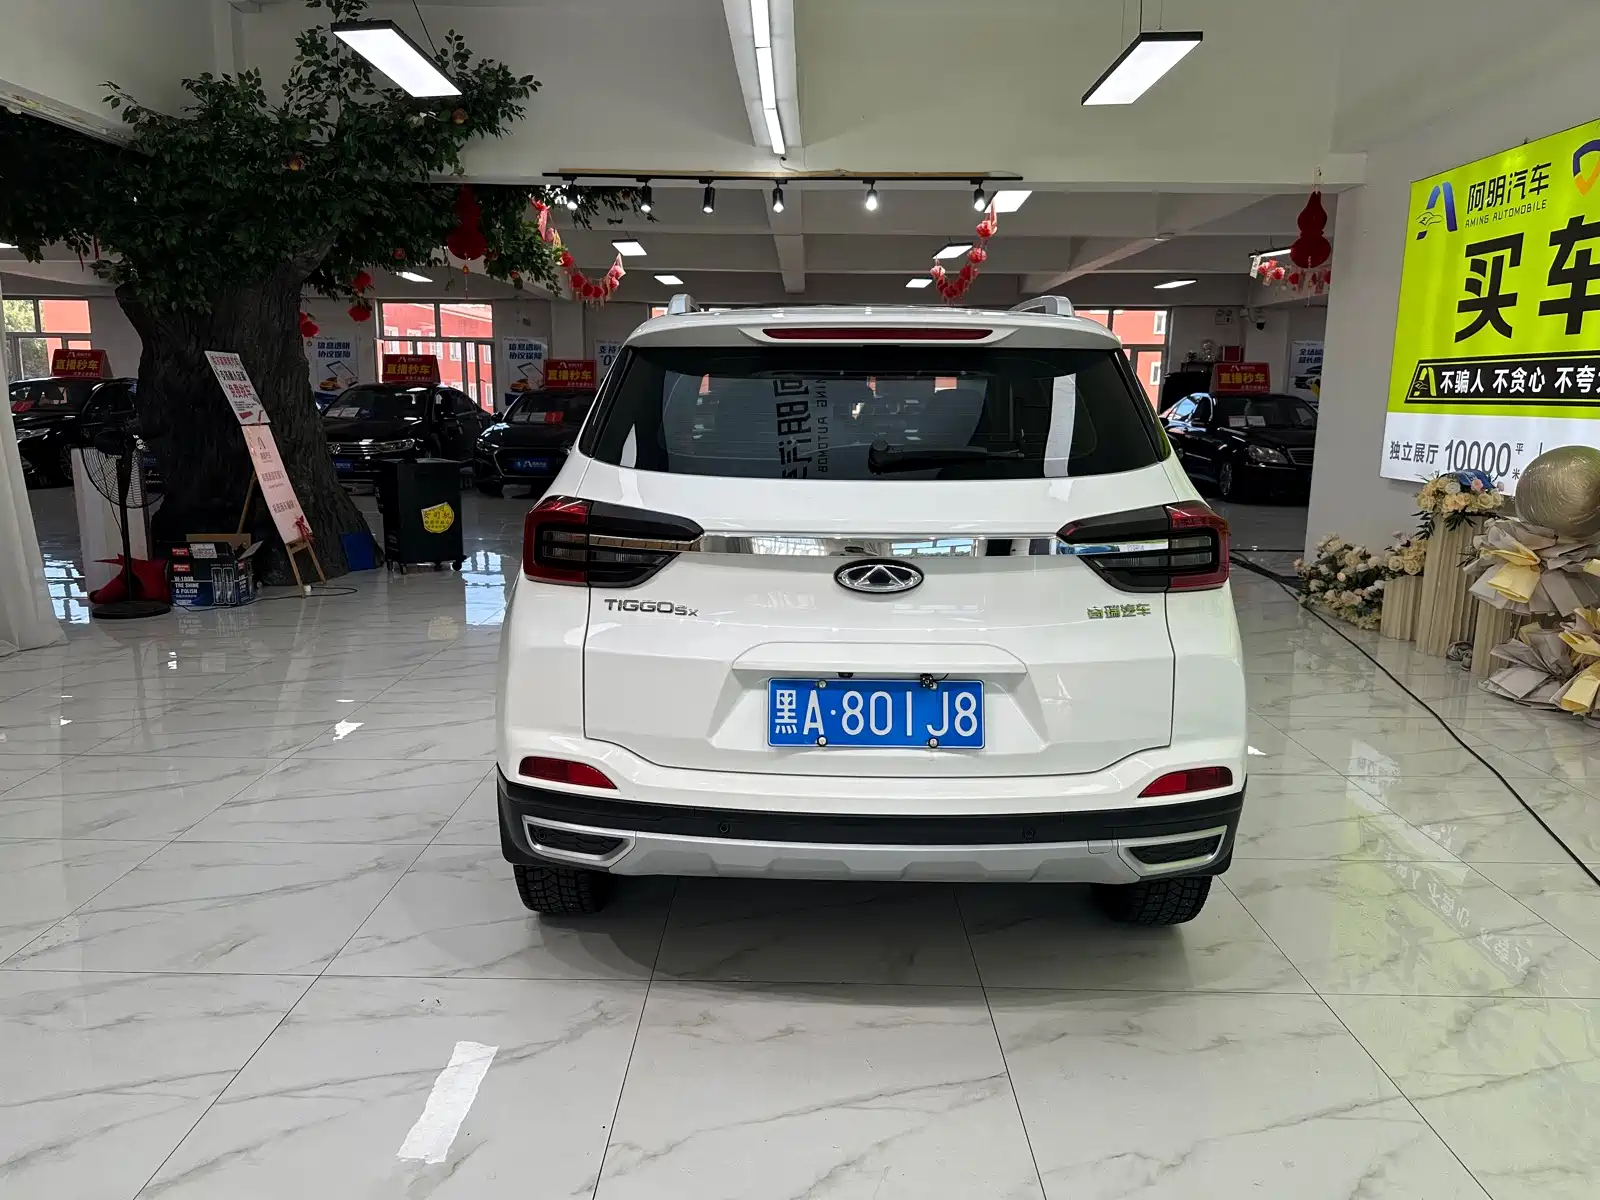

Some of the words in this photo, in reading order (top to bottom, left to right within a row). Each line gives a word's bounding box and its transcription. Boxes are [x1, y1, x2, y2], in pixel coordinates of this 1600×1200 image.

[1466, 162, 1552, 214] 阿明汽车
[1465, 214, 1489, 229] AMING
[1492, 199, 1547, 222] AUTOMOBILE
[55, 359, 99, 371] 直播秒车
[386, 363, 432, 375] 直播秒车
[547, 369, 593, 381] 直播秒车
[1219, 372, 1266, 384] 直播秒车
[1440, 368, 1485, 394] 不骗人
[1492, 366, 1546, 394] 不贪心
[1554, 364, 1600, 394] 不夸
[1389, 440, 1439, 465] 独立展厅
[1444, 438, 1512, 478] 10000
[1087, 603, 1151, 619] 奇瑞汽车
